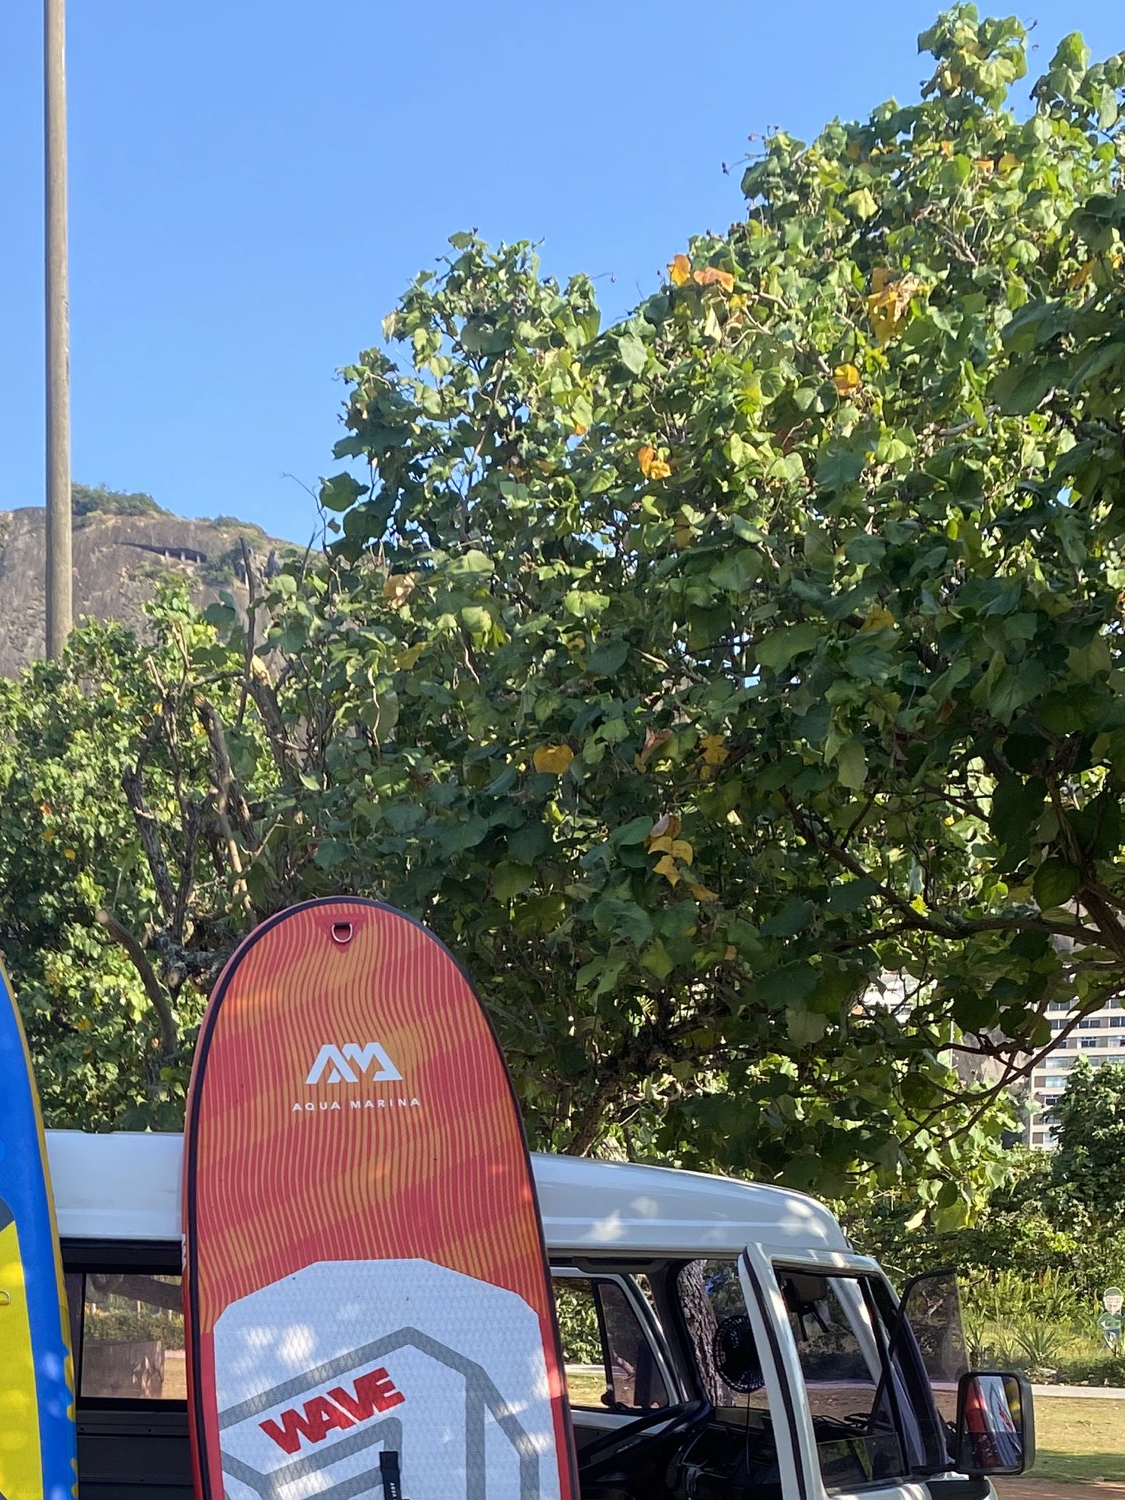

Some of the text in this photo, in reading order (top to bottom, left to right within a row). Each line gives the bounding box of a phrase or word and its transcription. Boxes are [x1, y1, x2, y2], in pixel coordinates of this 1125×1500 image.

[292, 1097, 420, 1112] AQUA MARINA
[258, 1367, 406, 1454] WAVE
